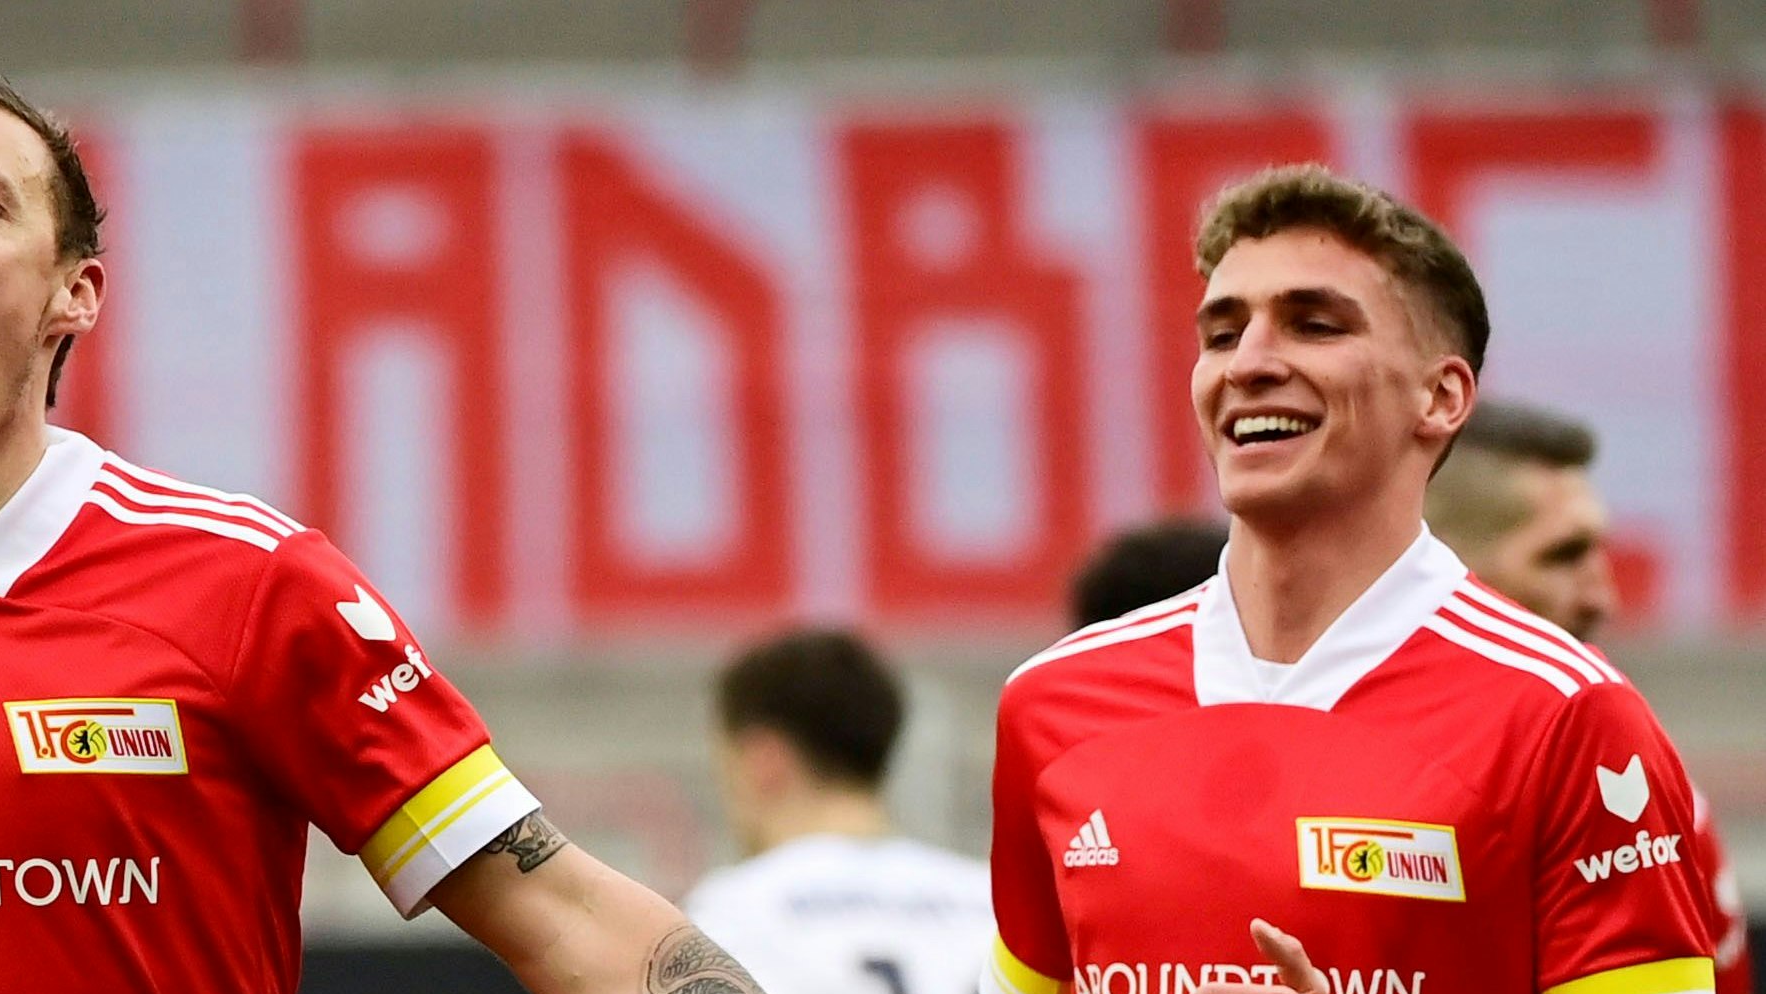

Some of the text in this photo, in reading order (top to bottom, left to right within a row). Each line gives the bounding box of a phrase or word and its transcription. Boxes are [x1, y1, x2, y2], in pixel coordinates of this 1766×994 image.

[107, 728, 173, 758] UNION
[1063, 846, 1120, 868] adidas
[1386, 850, 1448, 884] UNION
[1572, 829, 1682, 884] wefox
